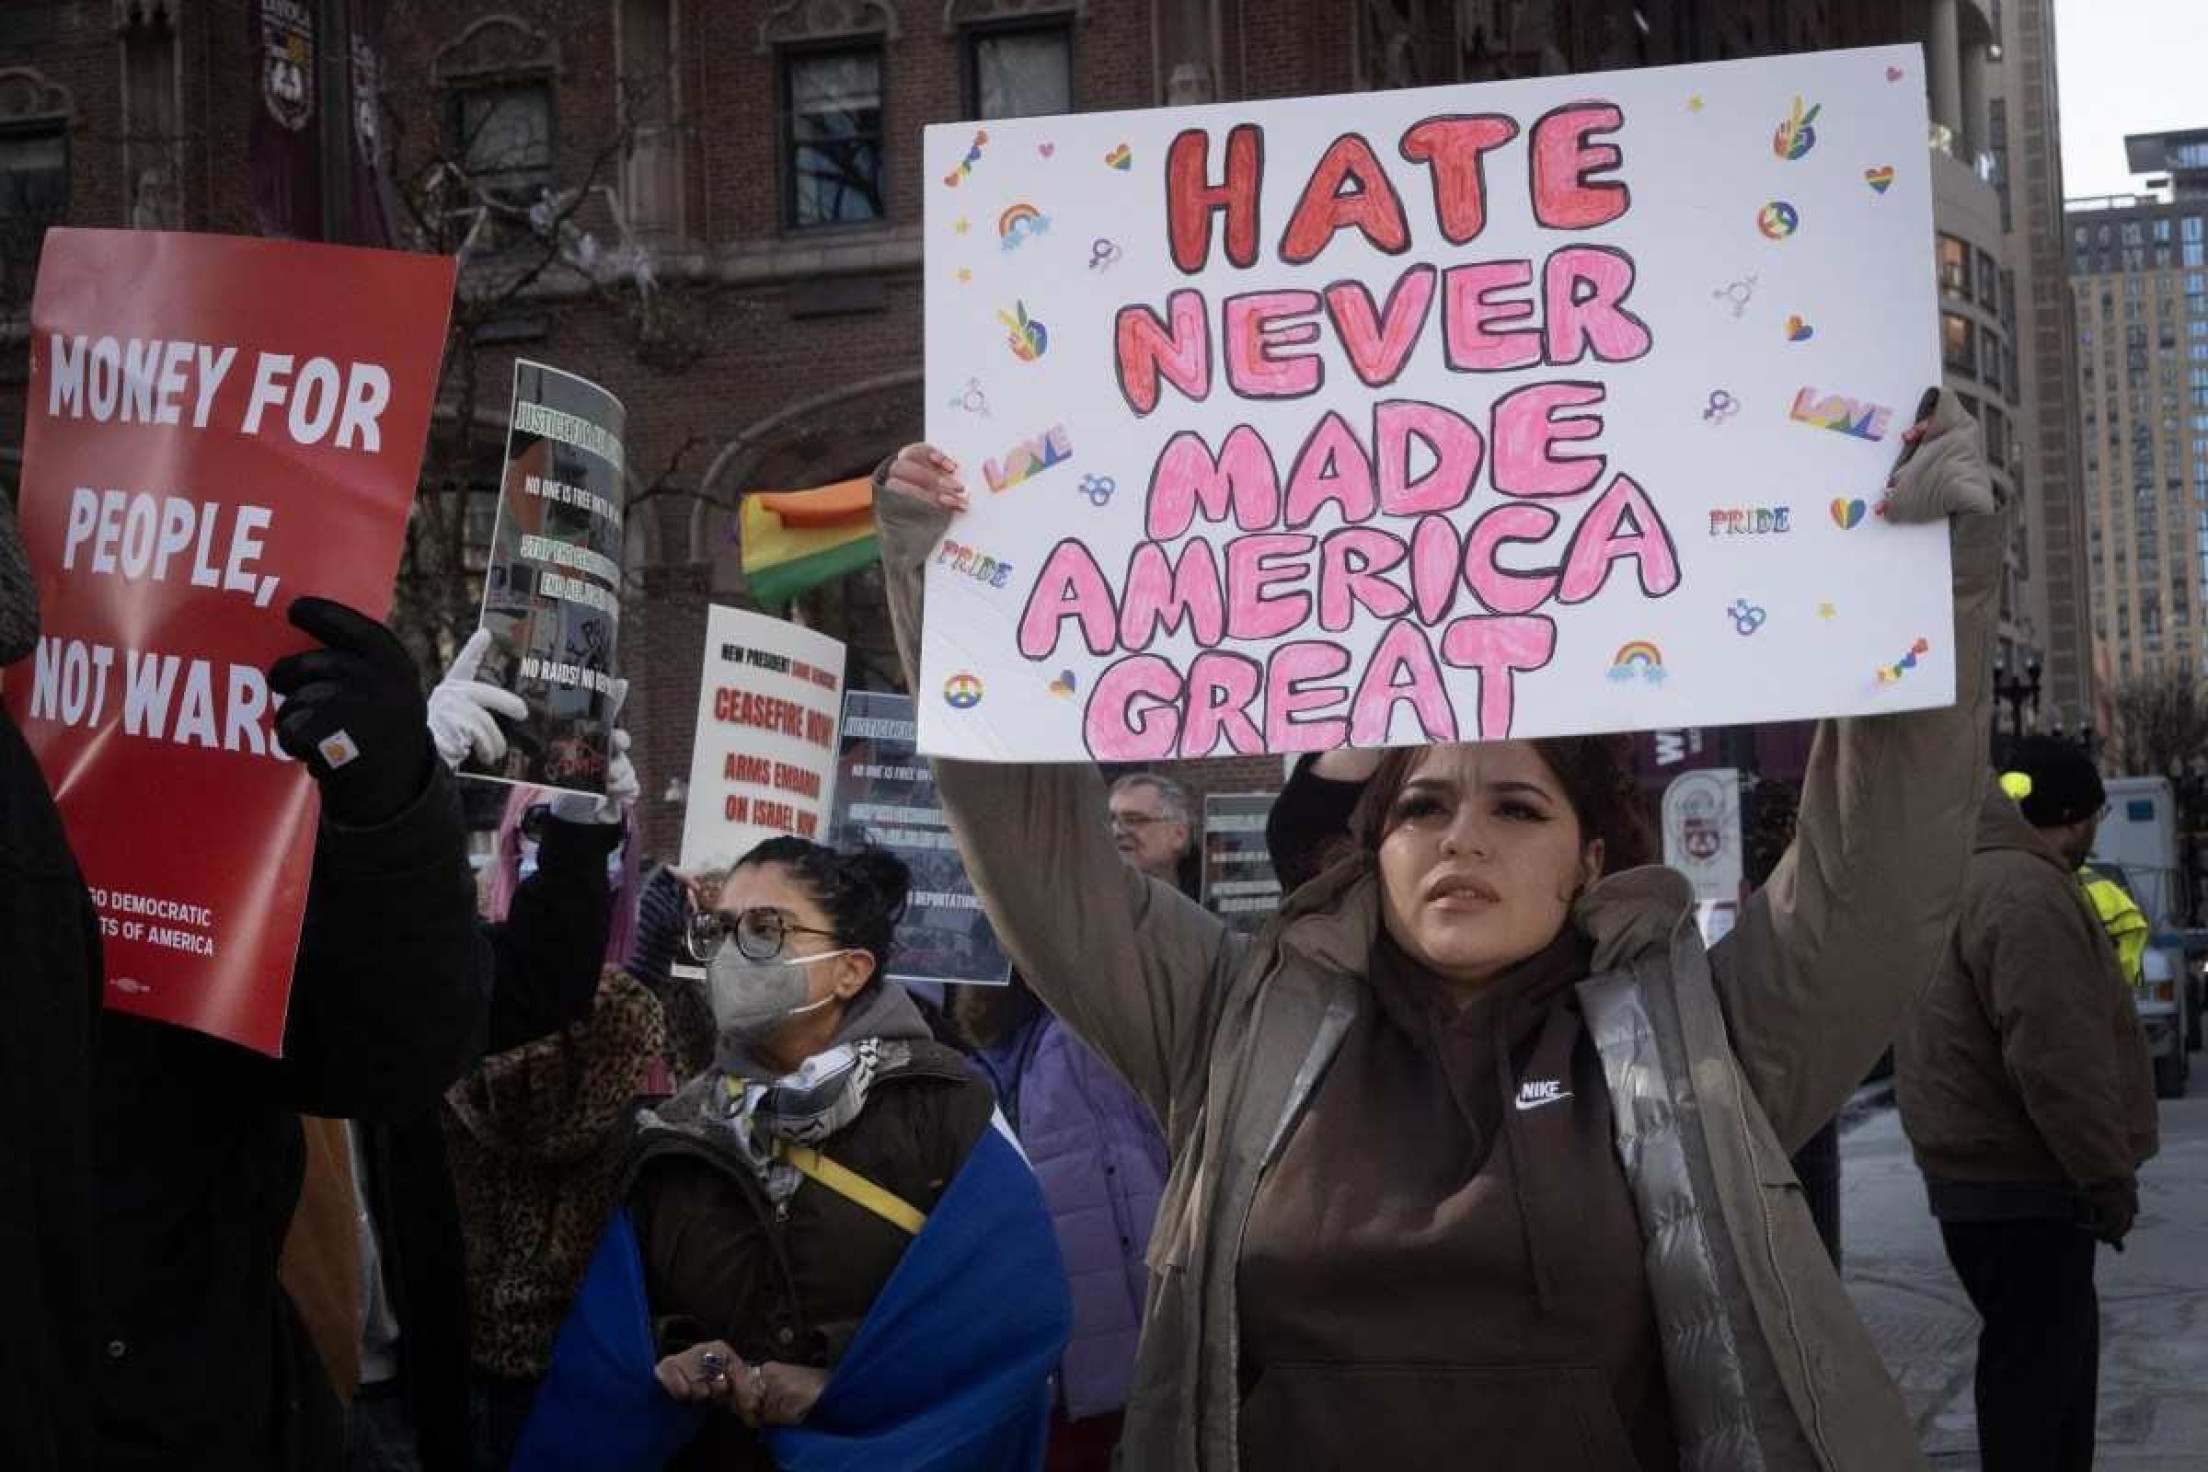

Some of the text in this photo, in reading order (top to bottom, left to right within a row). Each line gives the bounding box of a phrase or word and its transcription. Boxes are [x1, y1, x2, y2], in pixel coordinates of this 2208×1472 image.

[1166, 101, 1630, 274] HATE
[1115, 244, 1653, 416] NEVER
[49, 334, 390, 452] MONEY FOR
[1789, 386, 1894, 442] LOVE
[983, 424, 1072, 493] LOVE
[1145, 381, 1607, 540] MADE
[64, 487, 280, 607] PEOPLE,
[1708, 506, 1791, 536] PRIDE
[938, 540, 1013, 589] PRIDE
[1016, 473, 1681, 660] AMERICA
[520, 657, 540, 678] NO
[541, 659, 580, 687] RAIDS!
[721, 643, 744, 663] NEW
[30, 635, 114, 728] NOT
[1083, 614, 1556, 761] GREAT
[714, 687, 804, 738] CEASEFIRE
[724, 752, 770, 785] ARMS
[725, 795, 748, 824] ON
[753, 799, 794, 832] ISRAEL
[111, 891, 212, 927] DEMOCRATIC
[122, 921, 145, 941] OF
[147, 926, 213, 956] AMERICA
[1521, 1080, 1560, 1100] NIKE
